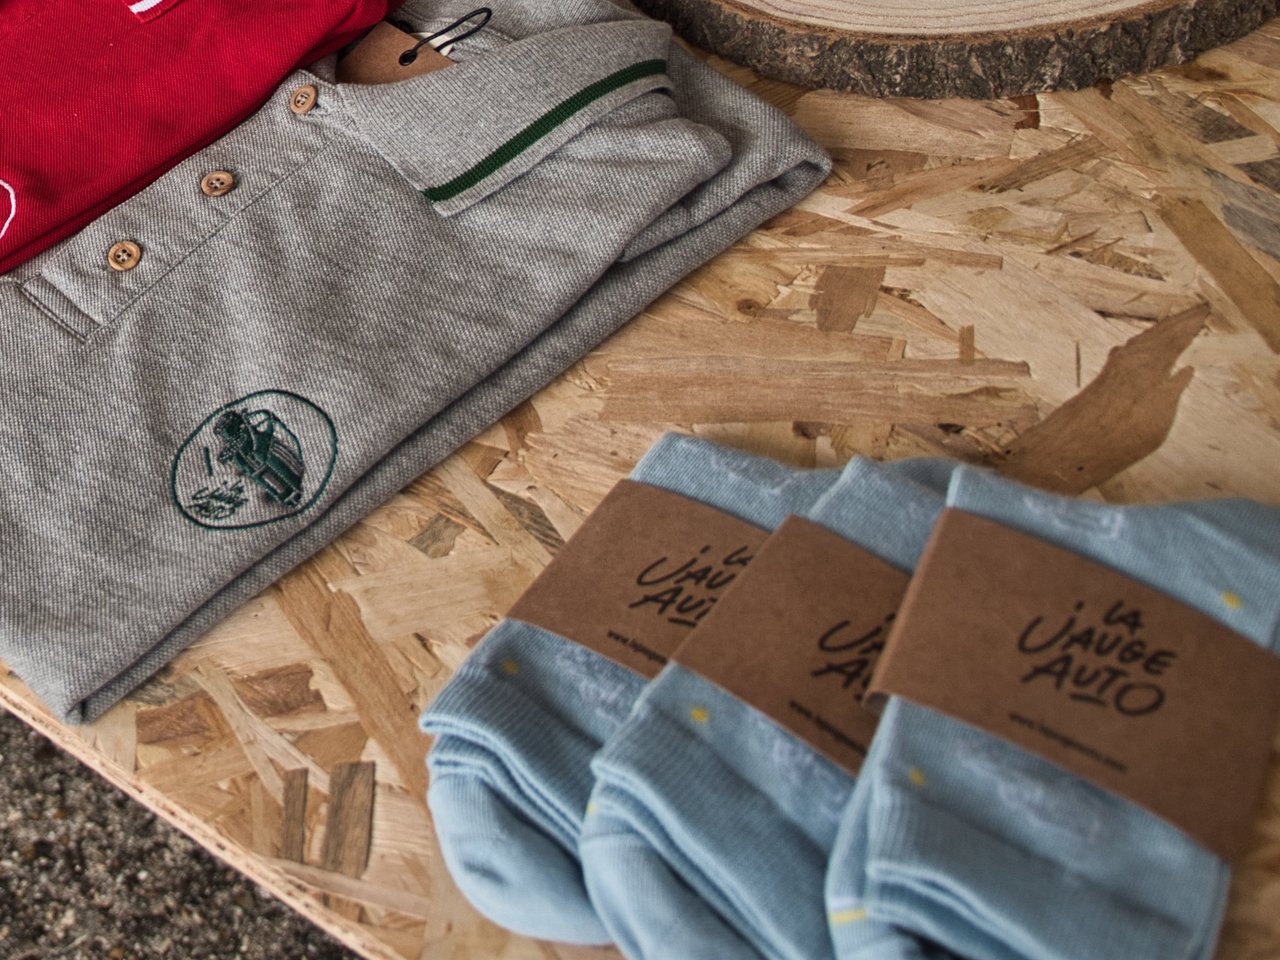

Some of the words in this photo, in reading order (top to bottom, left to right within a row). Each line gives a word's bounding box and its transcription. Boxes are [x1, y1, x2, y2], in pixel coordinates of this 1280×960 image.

[636, 545, 736, 590] JAU
[1018, 601, 1178, 676] JAUGE
[1104, 600, 1145, 636] LA
[1021, 654, 1165, 717] AUTO
